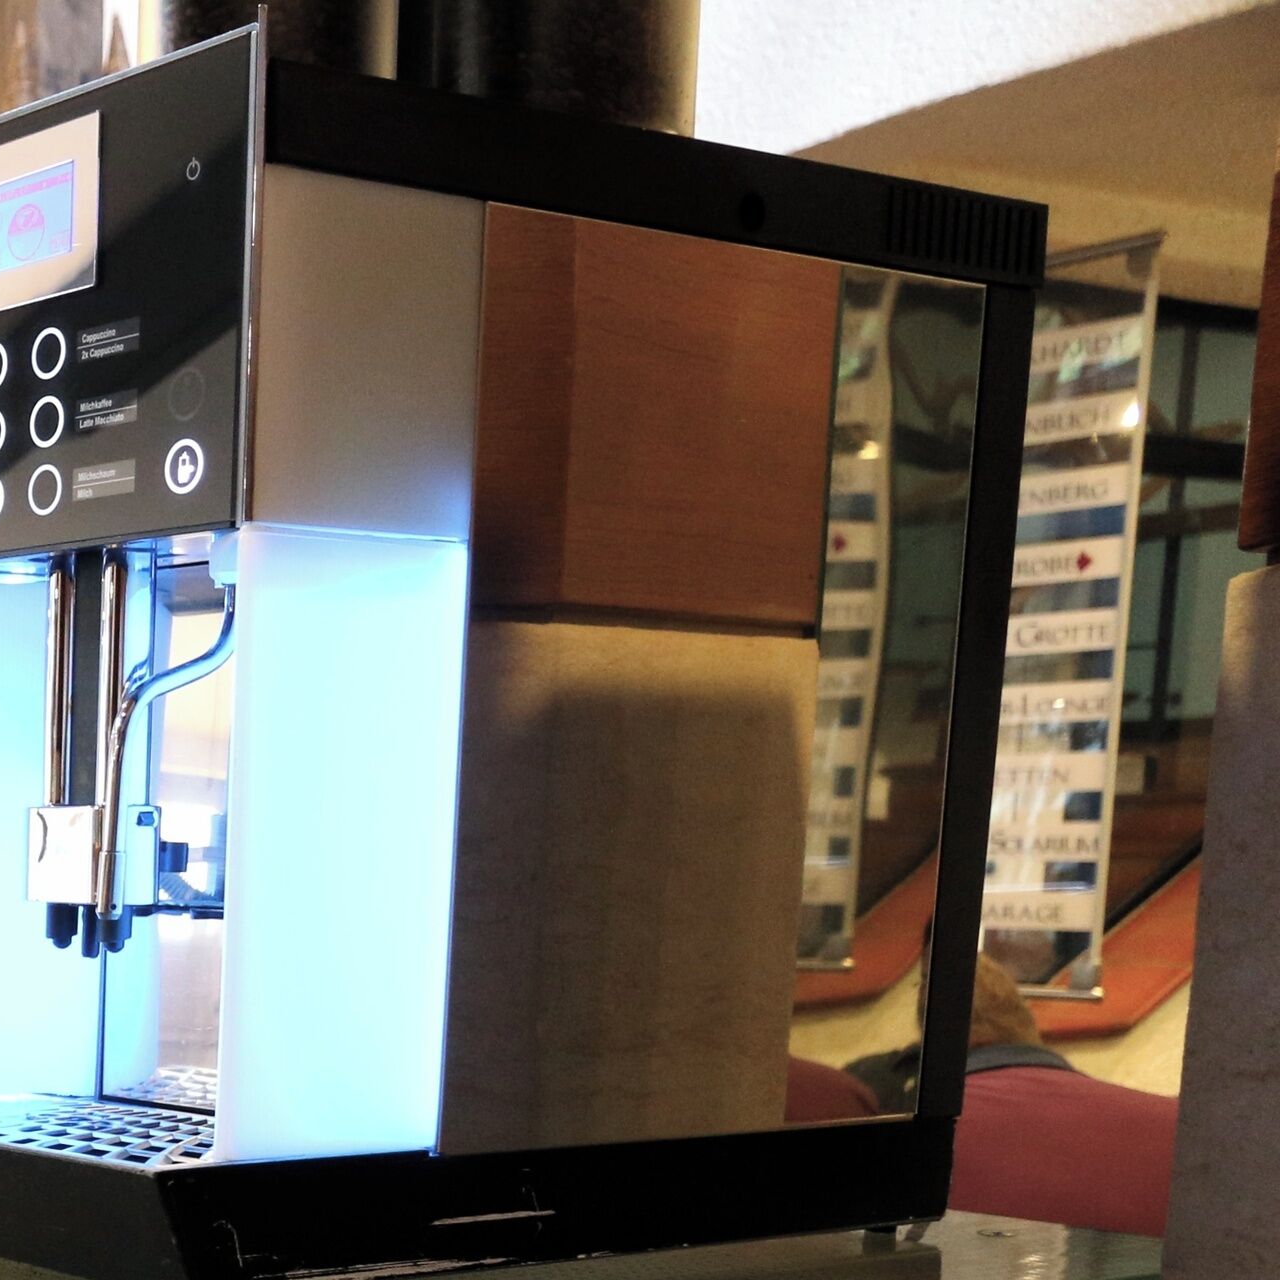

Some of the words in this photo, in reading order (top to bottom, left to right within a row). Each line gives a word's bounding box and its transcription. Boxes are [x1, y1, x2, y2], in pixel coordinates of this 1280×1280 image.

[81, 328, 117, 344] Cappuccino
[81, 349, 89, 360] 2x
[89, 343, 124, 359] Cappuccino
[1033, 331, 1126, 362] HARDT
[79, 398, 113, 412] Milchkaffee
[79, 417, 94, 429] Latte
[94, 412, 125, 426] Macchiato
[77, 468, 116, 482] Milchschaum
[77, 488, 93, 499] Milch
[1015, 554, 1073, 576] ROBE
[1016, 620, 1110, 648] GROTTE
[996, 767, 1070, 785] ETTEN
[990, 829, 1101, 854] SOLARIUM
[983, 902, 1063, 923] ARAGE
